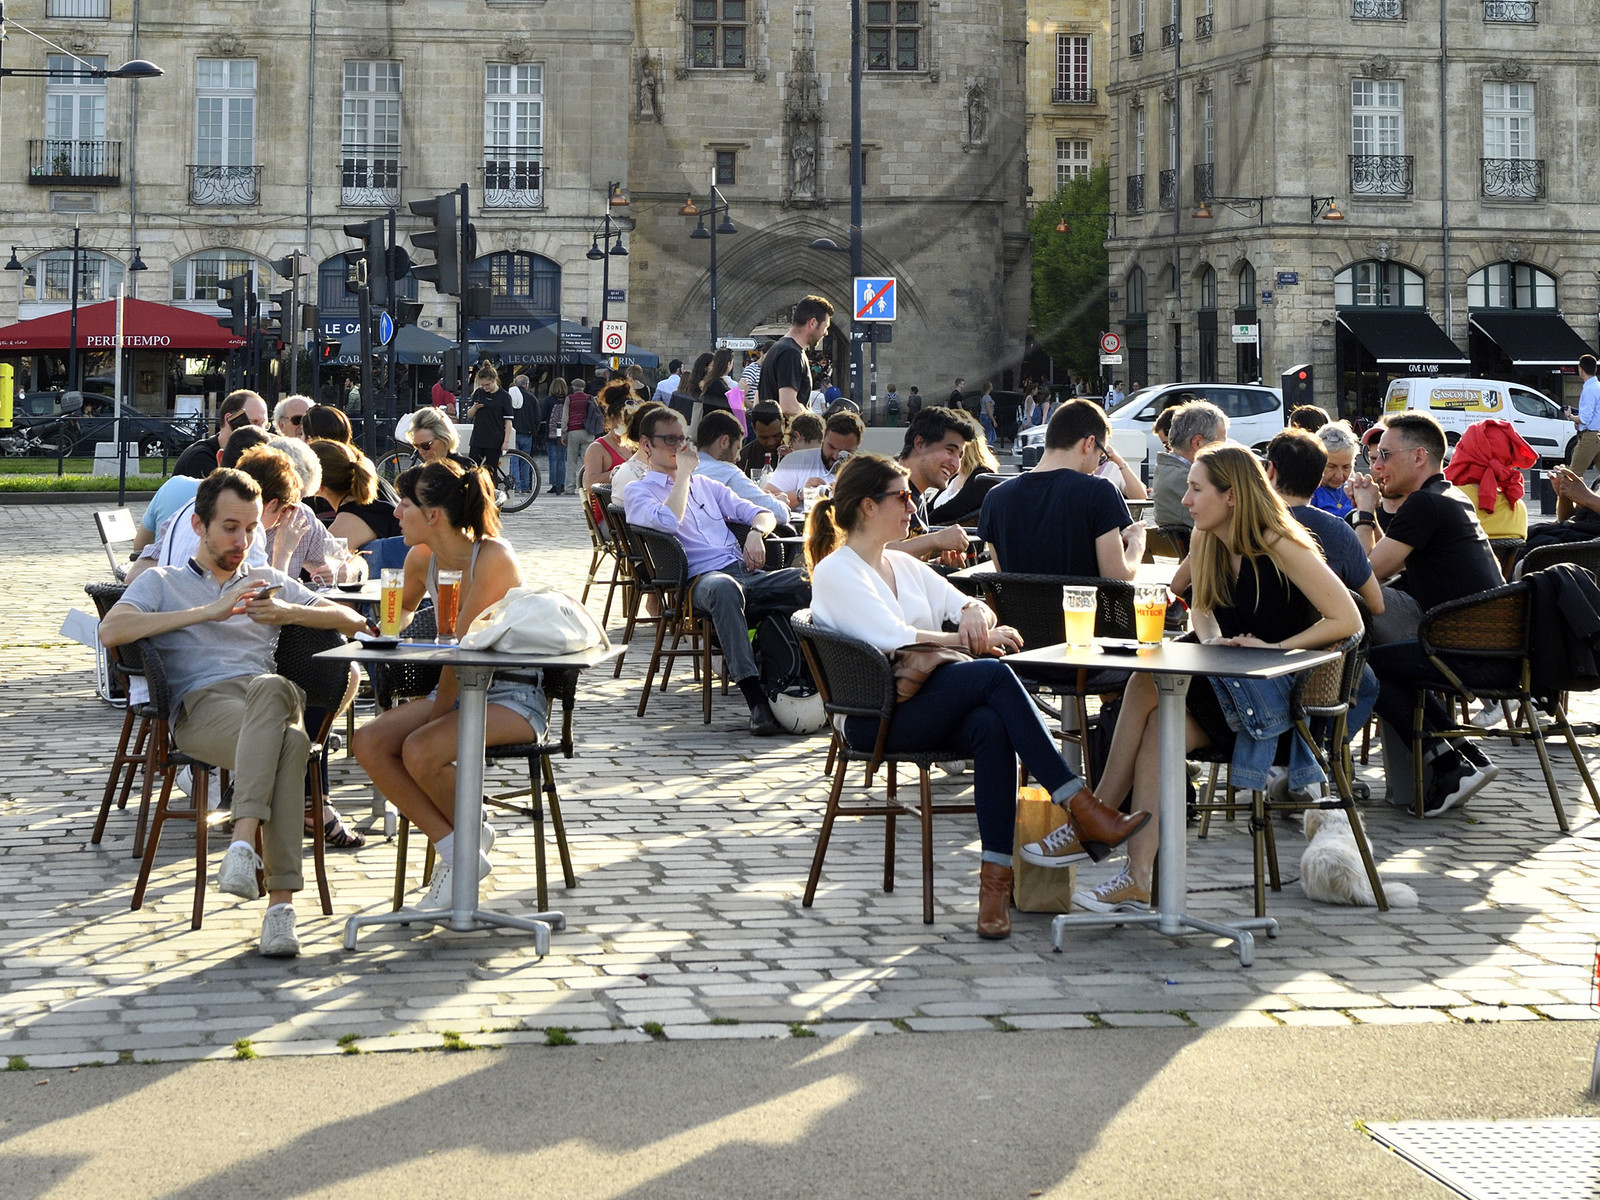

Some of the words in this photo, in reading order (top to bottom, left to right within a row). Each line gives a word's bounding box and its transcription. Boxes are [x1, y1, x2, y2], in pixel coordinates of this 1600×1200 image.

[325, 324, 341, 334] LE
[489, 325, 531, 335] MARIN
[609, 337, 620, 345] 30
[508, 355, 521, 363] LE
[387, 590, 397, 624] METEOR
[1136, 608, 1163, 617] METEOR
